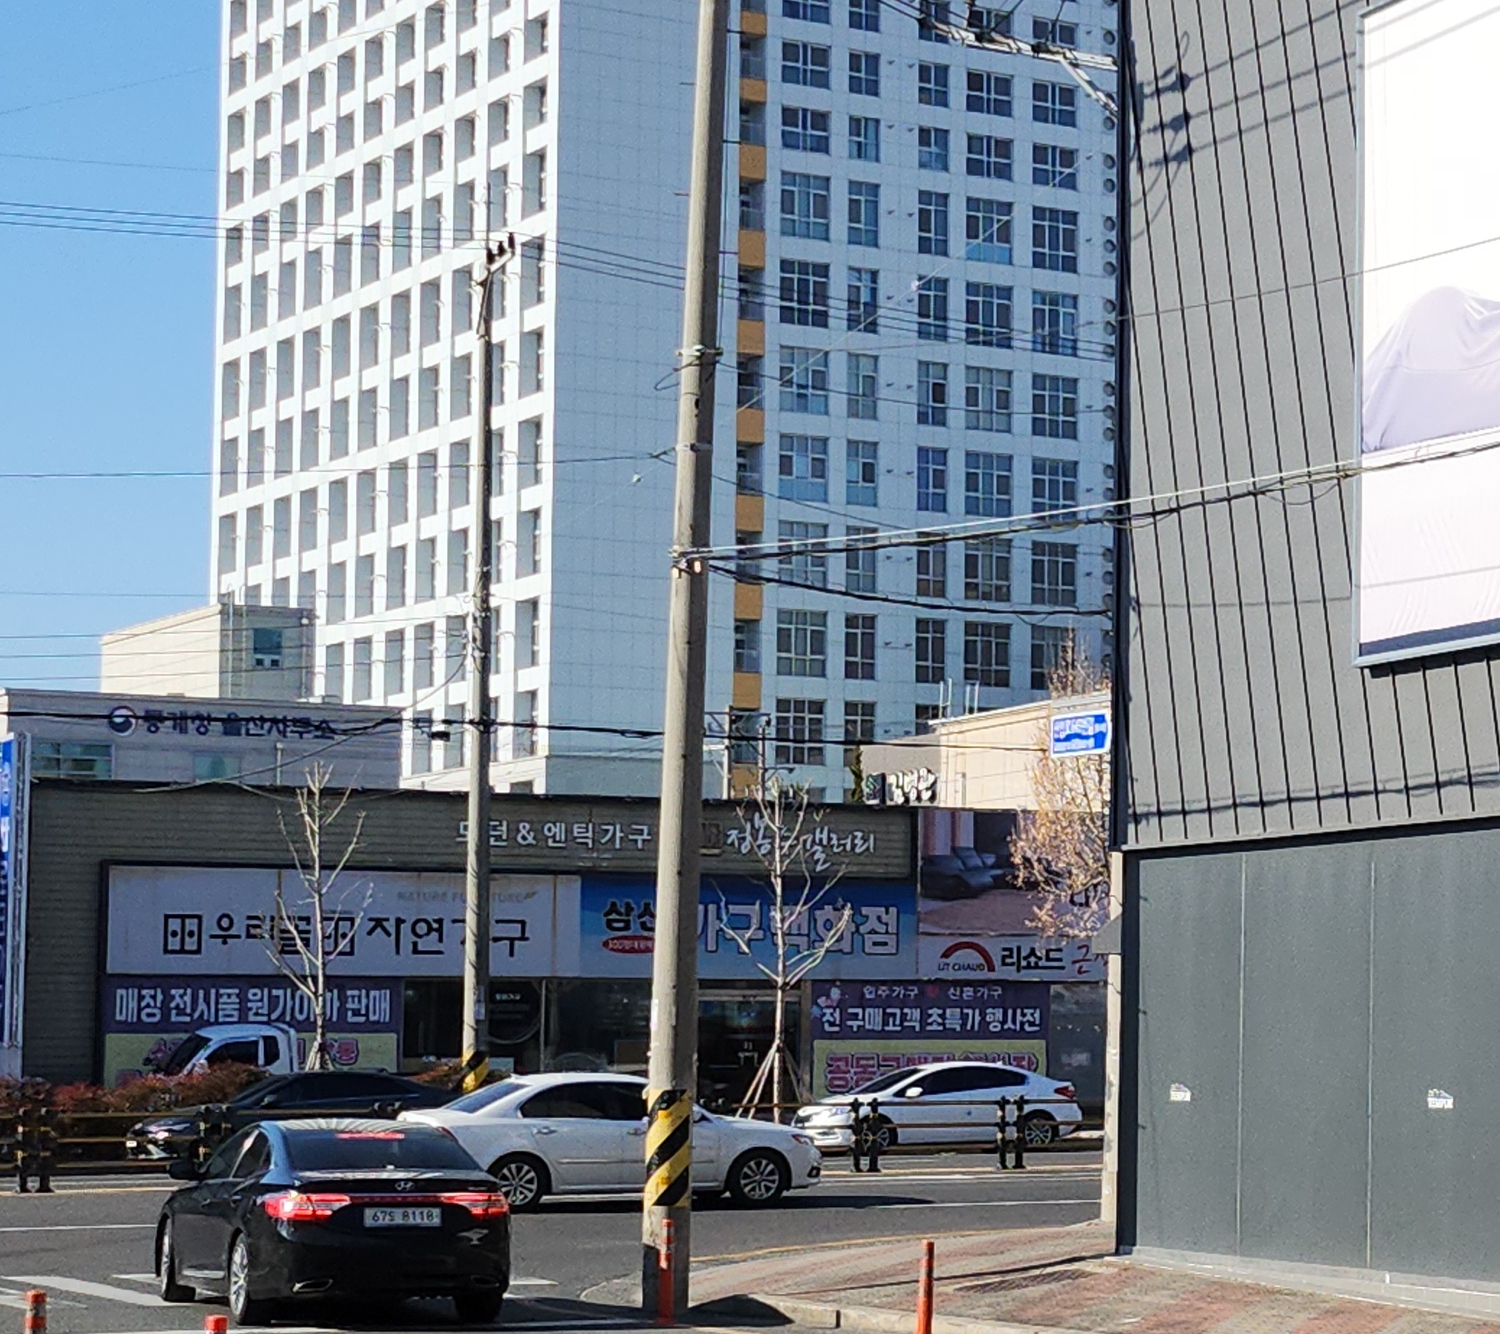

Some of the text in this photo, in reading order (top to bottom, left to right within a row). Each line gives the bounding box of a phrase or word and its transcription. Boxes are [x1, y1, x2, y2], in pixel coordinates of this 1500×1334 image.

[1001, 945, 1066, 973] 리쇼드
[115, 987, 163, 1023] 매장
[169, 987, 241, 1023] 전시품
[346, 988, 391, 1024] 판매
[947, 985, 1003, 1000] 신혼가구
[822, 1007, 1041, 1033] 전 구매고객 초특가 행사전
